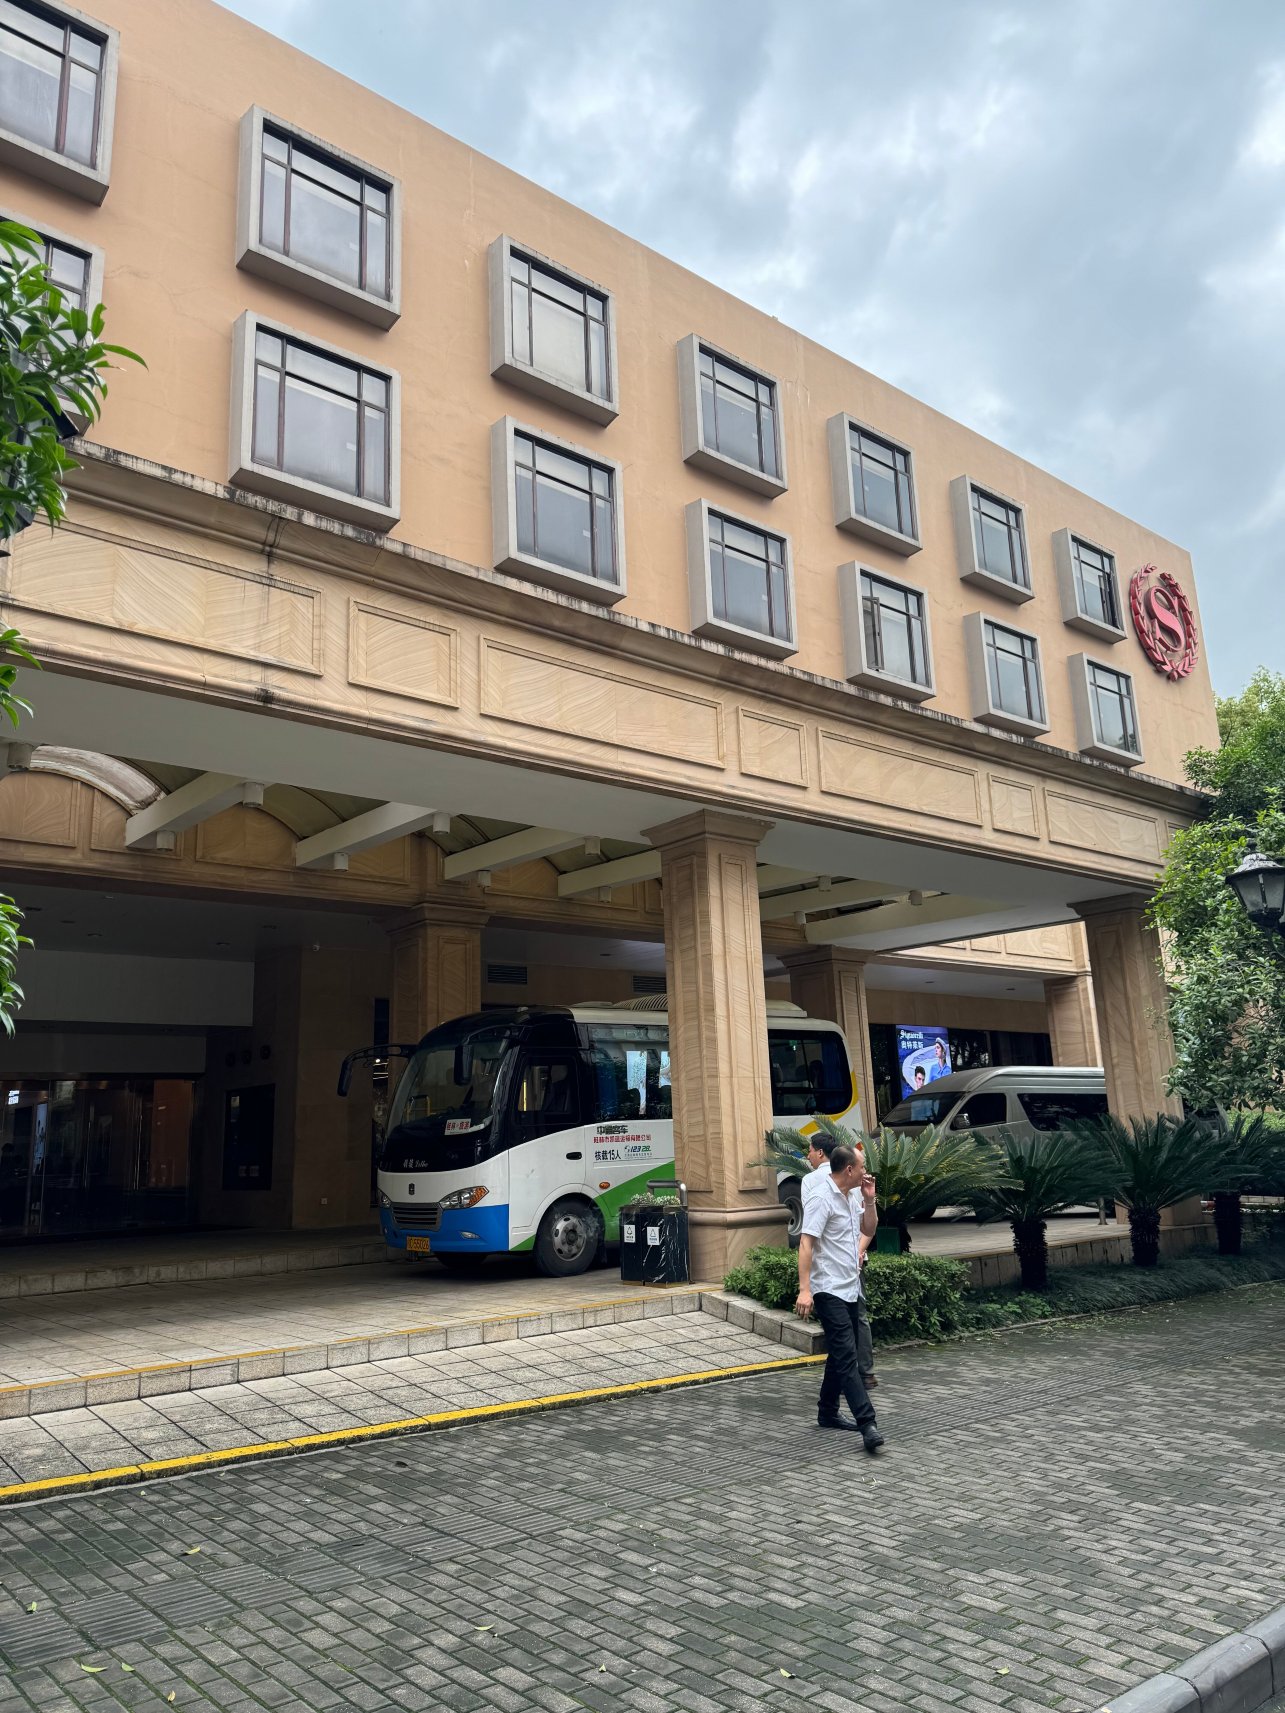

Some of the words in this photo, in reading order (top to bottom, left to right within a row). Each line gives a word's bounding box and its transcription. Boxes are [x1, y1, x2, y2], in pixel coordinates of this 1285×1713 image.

[1144, 586, 1185, 653] S
[595, 1149, 621, 1160] 核载15人
